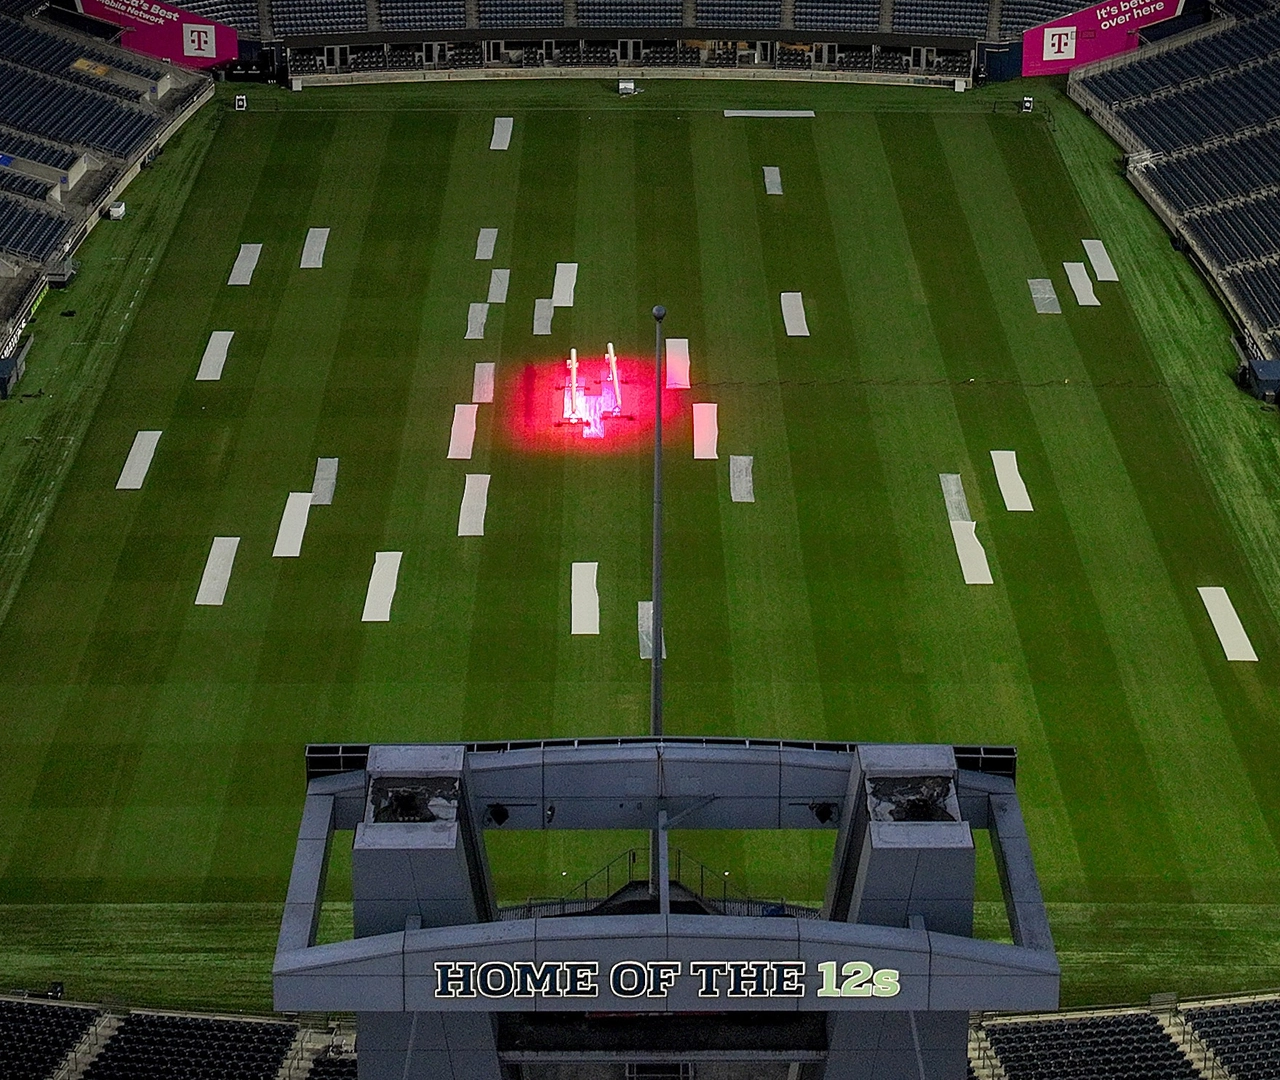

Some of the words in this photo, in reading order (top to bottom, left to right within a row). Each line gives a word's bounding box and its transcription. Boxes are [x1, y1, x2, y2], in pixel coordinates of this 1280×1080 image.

[126, 5, 165, 26] Network
[150, 3, 180, 22] Best
[1096, 2, 1118, 21] It's
[1100, 11, 1132, 30] over
[1133, 0, 1165, 21] here
[190, 29, 208, 52] T
[1050, 33, 1069, 54] T
[433, 960, 600, 999] HOME
[607, 960, 681, 999] OF
[690, 960, 807, 999] THE
[816, 960, 901, 999] 12s
